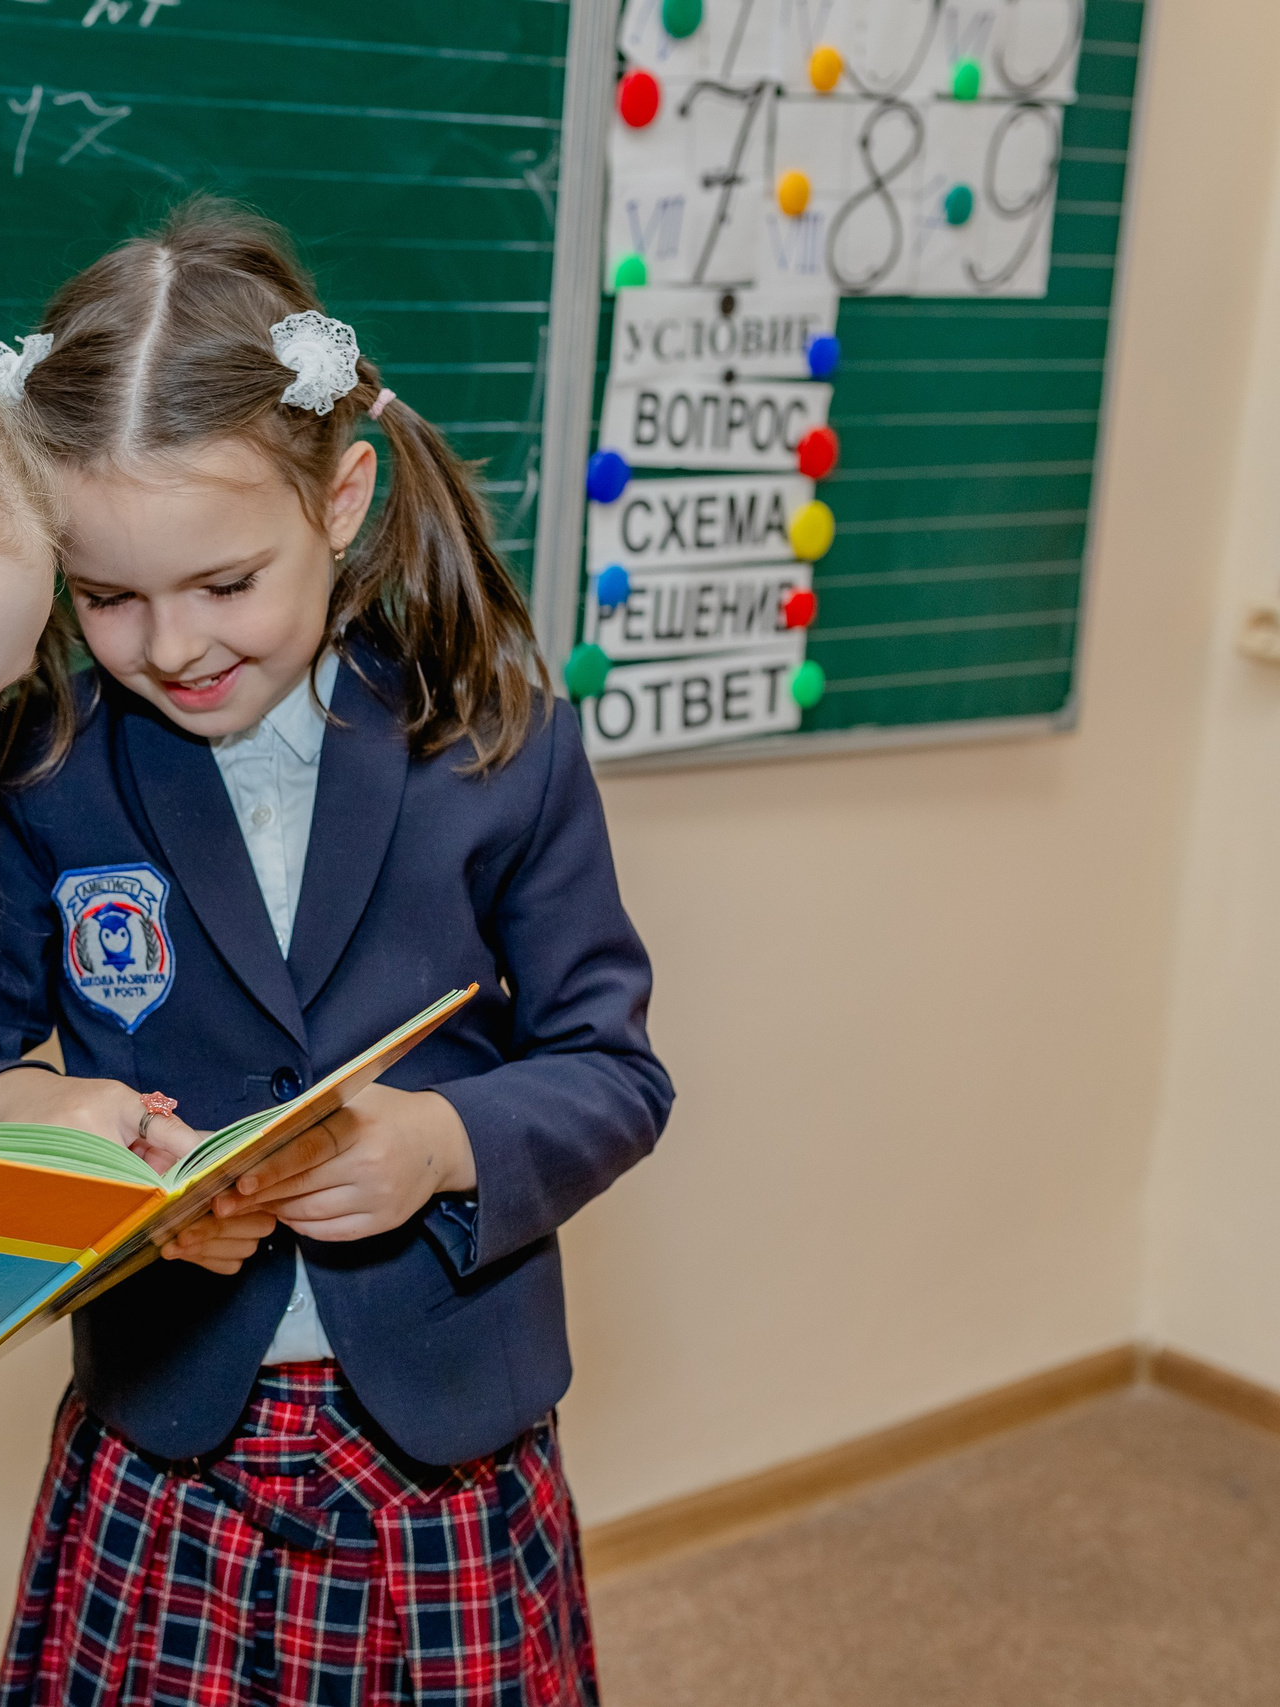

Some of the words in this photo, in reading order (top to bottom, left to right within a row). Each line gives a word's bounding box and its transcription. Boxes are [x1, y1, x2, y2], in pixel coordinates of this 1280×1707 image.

[678, 79, 770, 284] 7
[824, 99, 925, 296] 8
[962, 101, 1062, 288] 9
[633, 391, 809, 452] ВОПРОС
[621, 489, 789, 553] СХЕМА
[595, 663, 790, 741] ОТВЕТ
